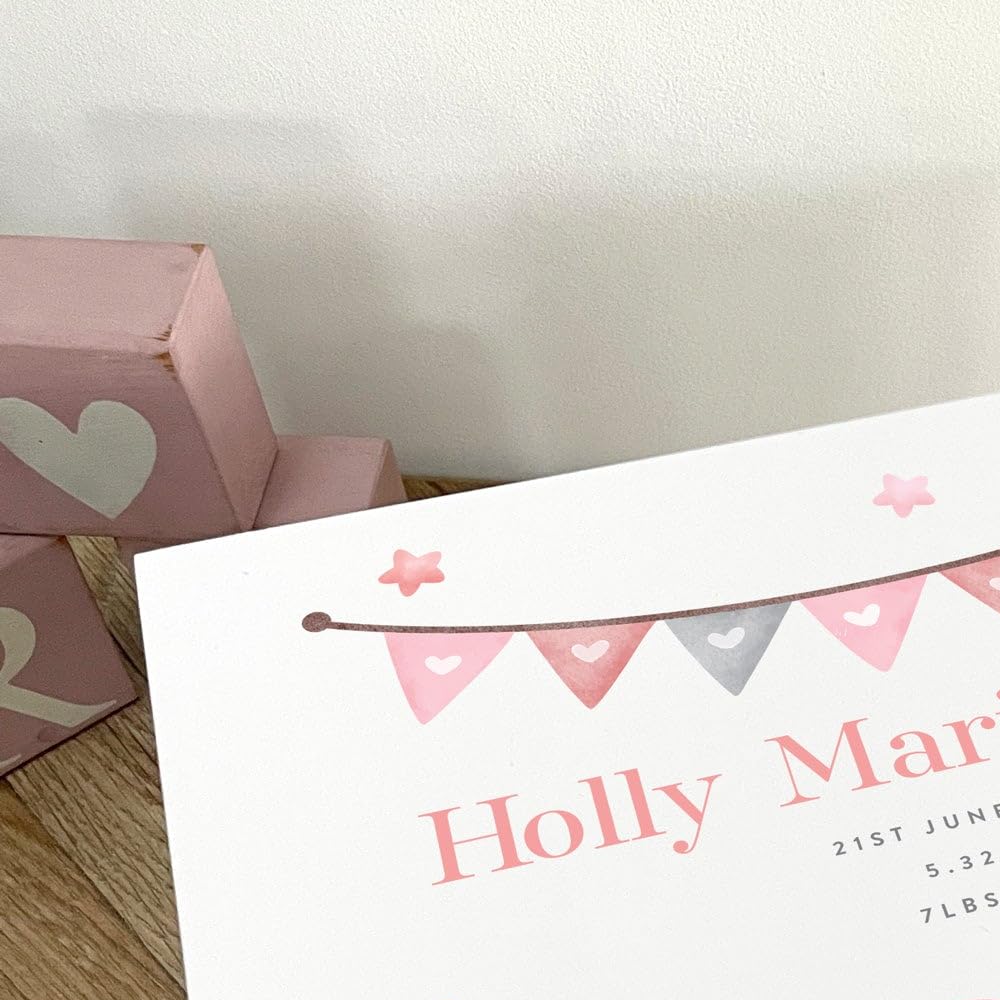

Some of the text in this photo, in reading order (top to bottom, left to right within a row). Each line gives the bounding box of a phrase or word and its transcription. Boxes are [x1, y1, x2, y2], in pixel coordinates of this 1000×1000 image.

[417, 768, 722, 886] Holly
[832, 826, 904, 857] 21ST
[919, 892, 1000, 924] 7LBS
